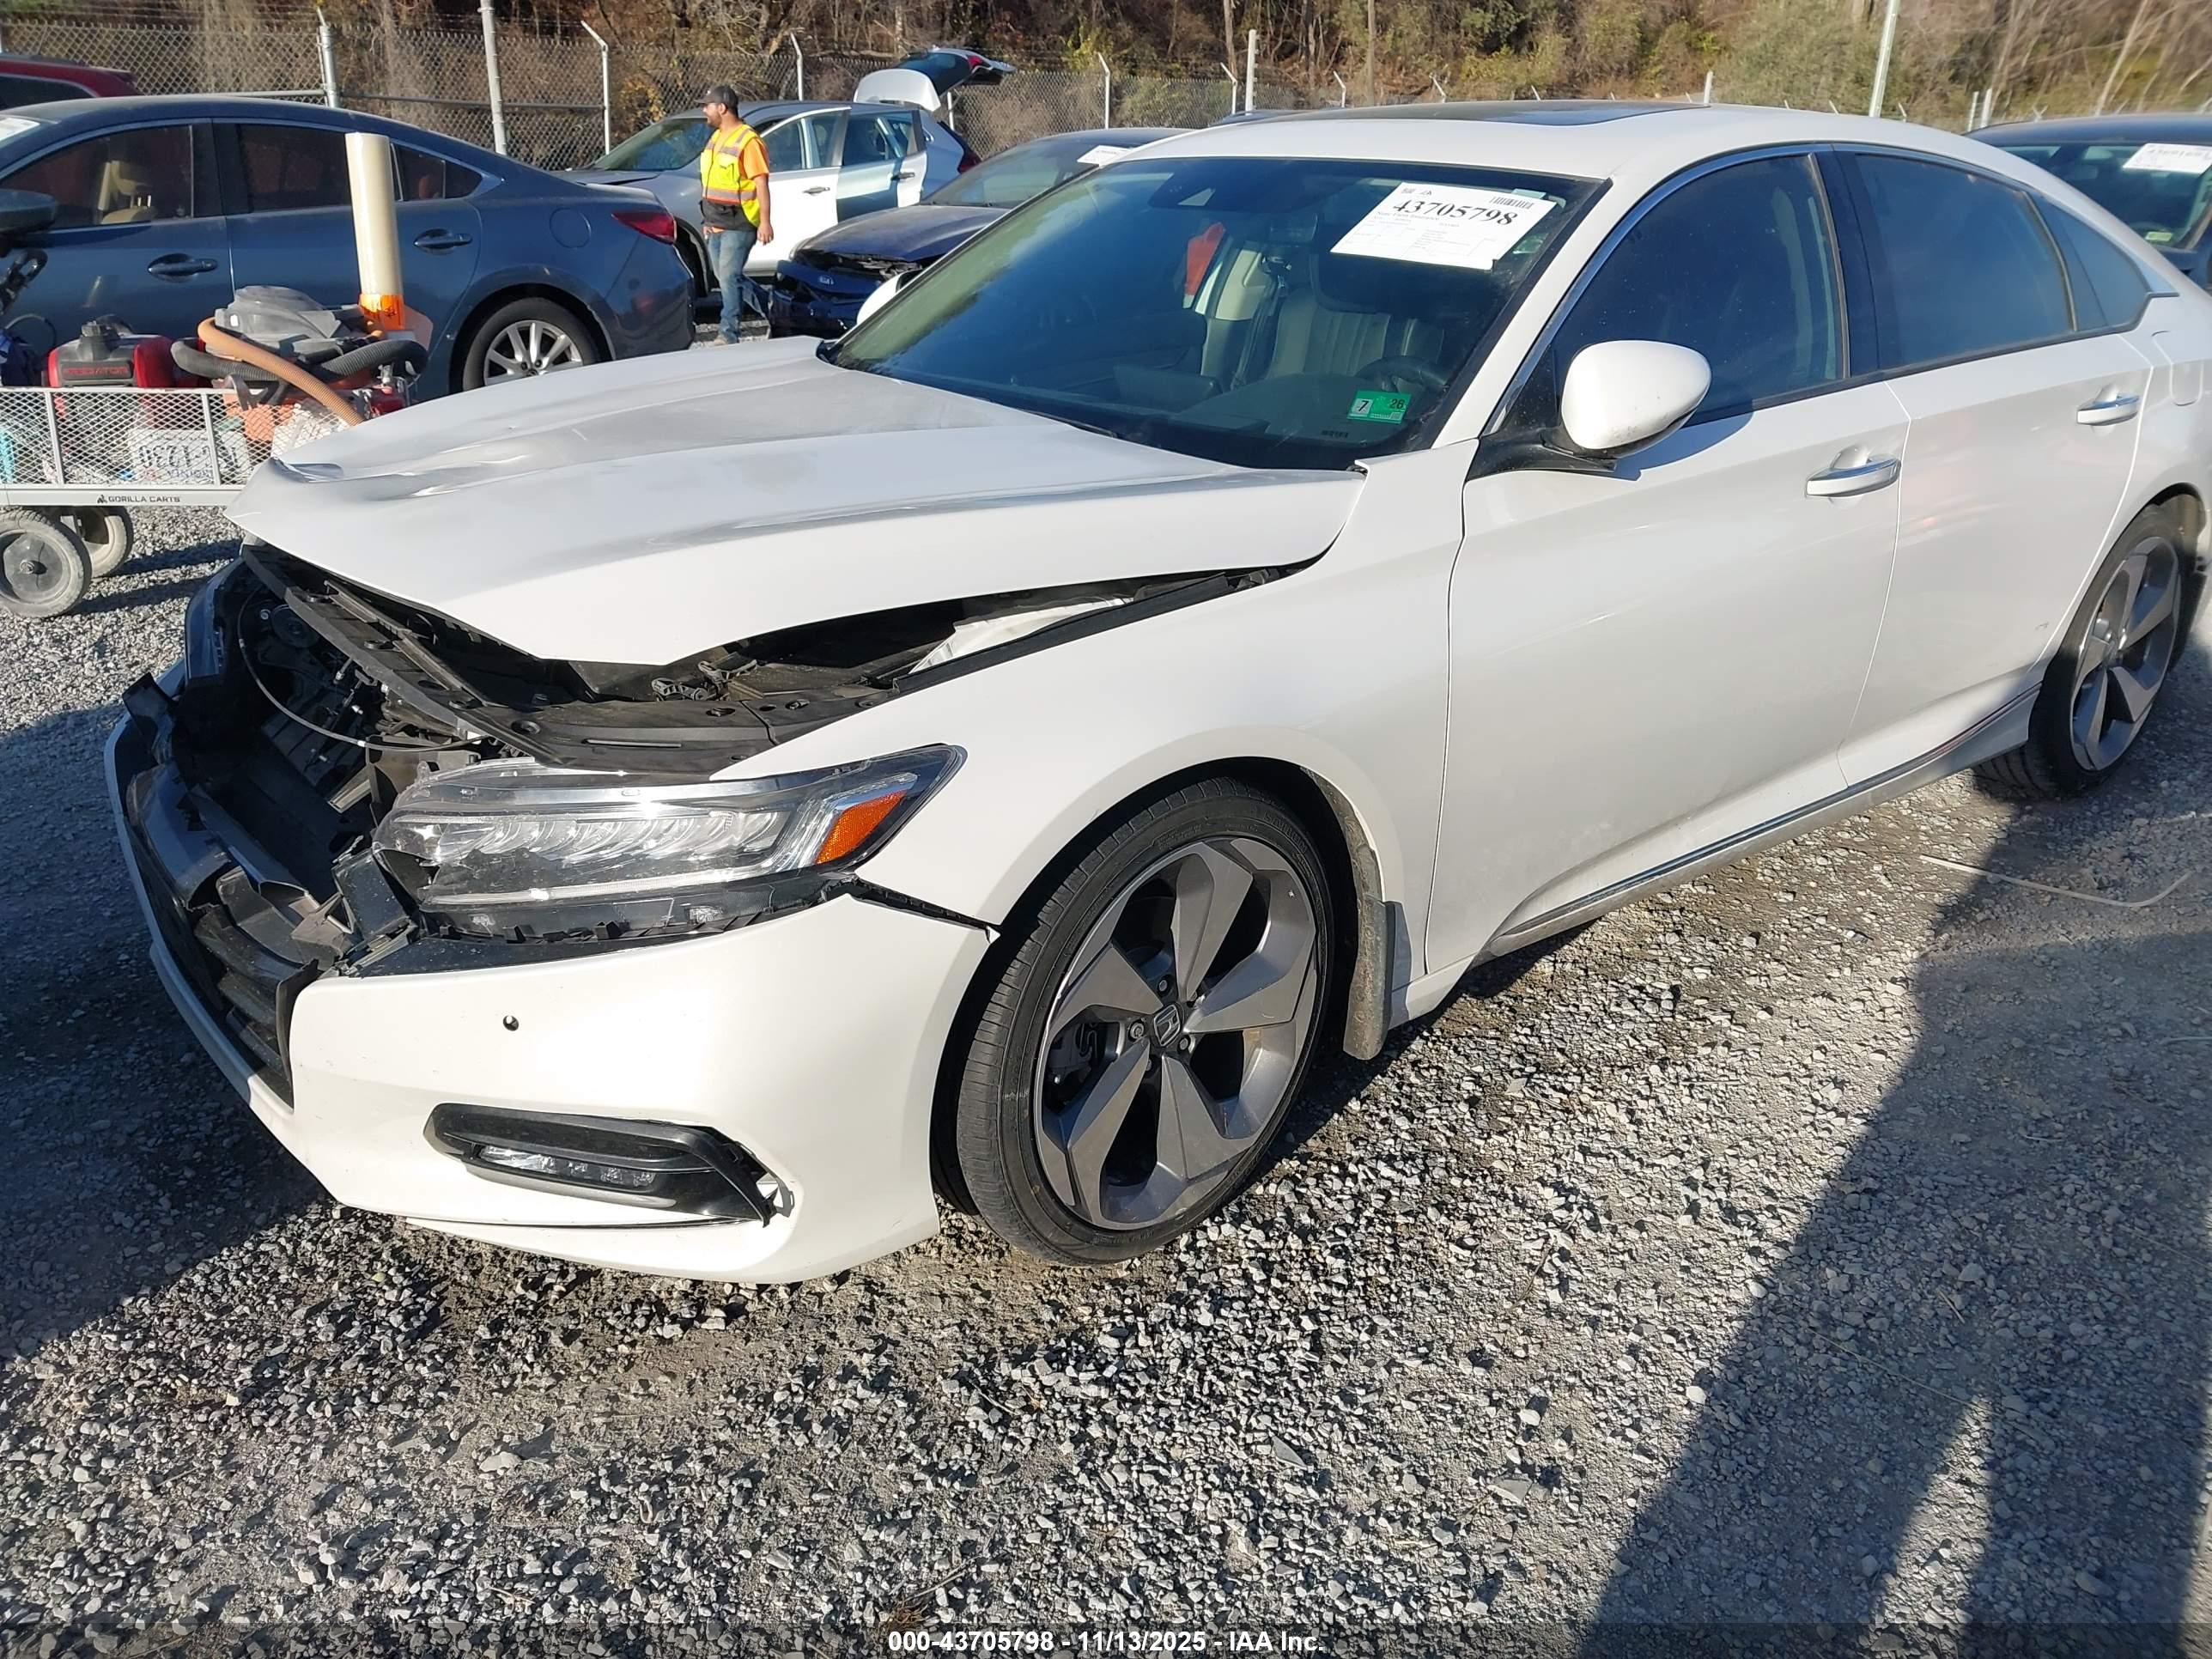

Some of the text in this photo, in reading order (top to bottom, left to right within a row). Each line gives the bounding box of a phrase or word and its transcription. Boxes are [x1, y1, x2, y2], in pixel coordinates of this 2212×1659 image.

[1393, 199, 1519, 226] 43705798
[1358, 400, 1370, 412] 7
[1389, 398, 1406, 410] 26
